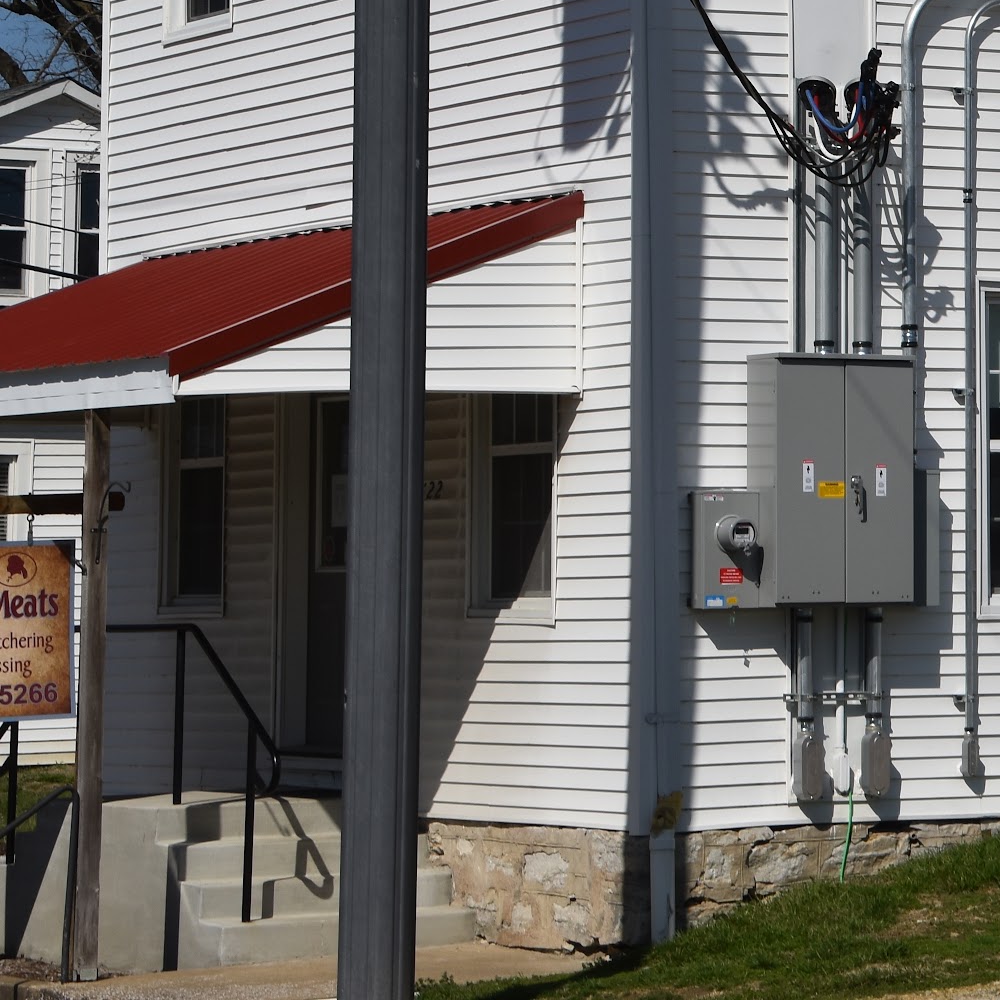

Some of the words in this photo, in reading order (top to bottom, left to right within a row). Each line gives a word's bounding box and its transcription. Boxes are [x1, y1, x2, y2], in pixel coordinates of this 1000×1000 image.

[423, 480, 443, 500] 22
[0, 631, 54, 654] chering
[0, 656, 32, 678] sing
[0, 682, 58, 705] 5266
